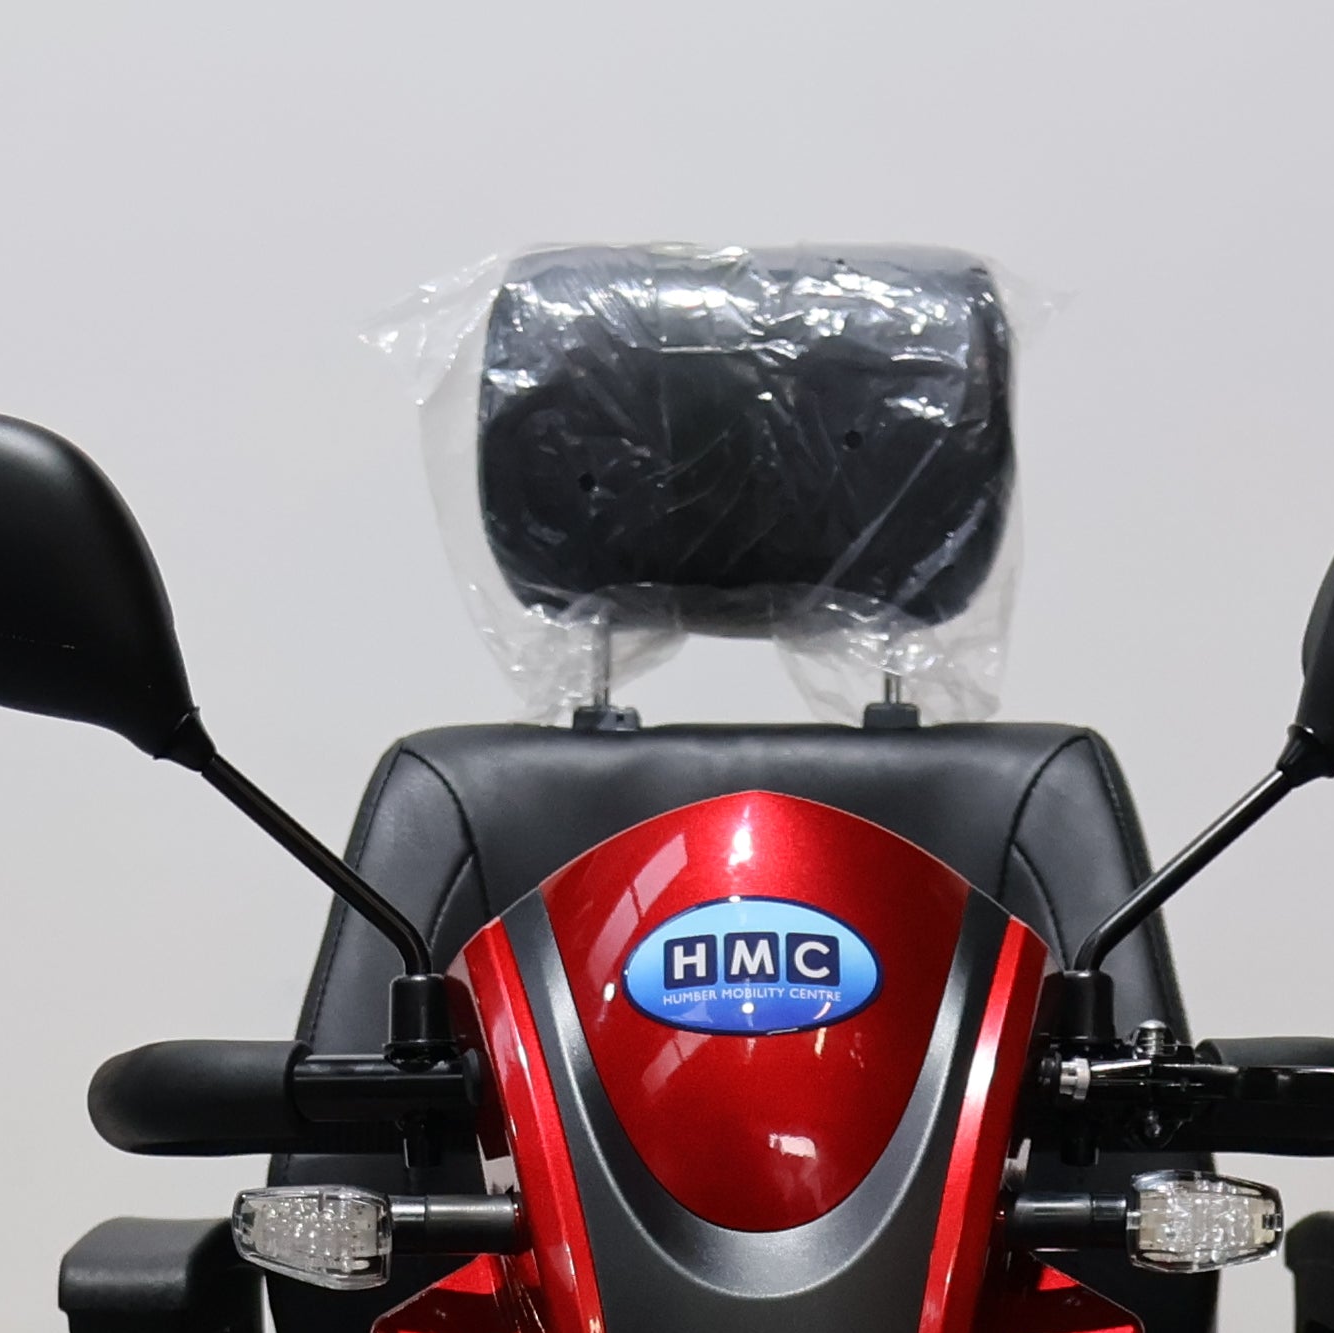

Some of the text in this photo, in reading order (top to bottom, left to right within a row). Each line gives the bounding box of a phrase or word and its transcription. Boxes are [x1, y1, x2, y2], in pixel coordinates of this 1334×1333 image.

[673, 939, 831, 980] HMC
[663, 987, 841, 1006] HUMBER MOBILITY CENTRE
